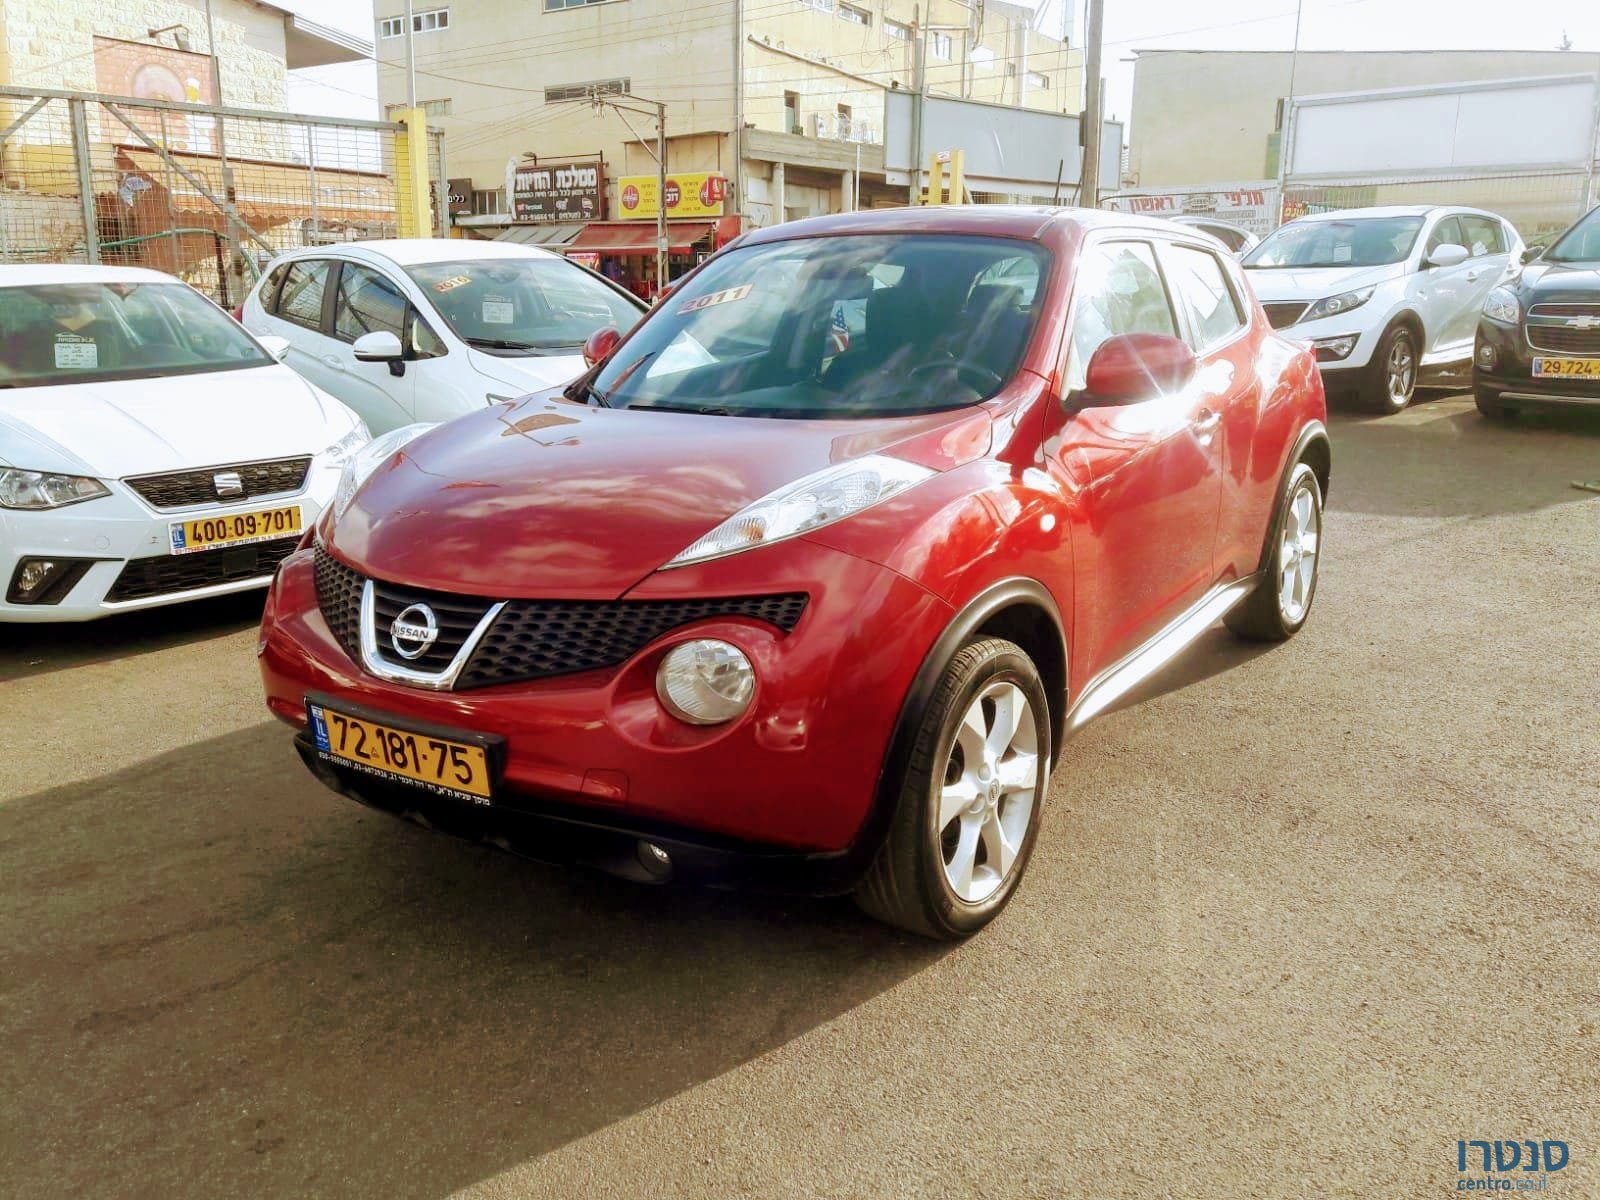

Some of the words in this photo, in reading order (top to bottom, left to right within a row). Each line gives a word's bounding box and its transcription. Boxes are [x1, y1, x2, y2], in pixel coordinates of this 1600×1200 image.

[516, 171, 551, 191] החיות
[555, 164, 597, 188] ממלכת
[1128, 196, 1176, 214] ראשון
[434, 276, 468, 292] 2016
[681, 287, 744, 311] 2011
[391, 621, 430, 640] NISSAN
